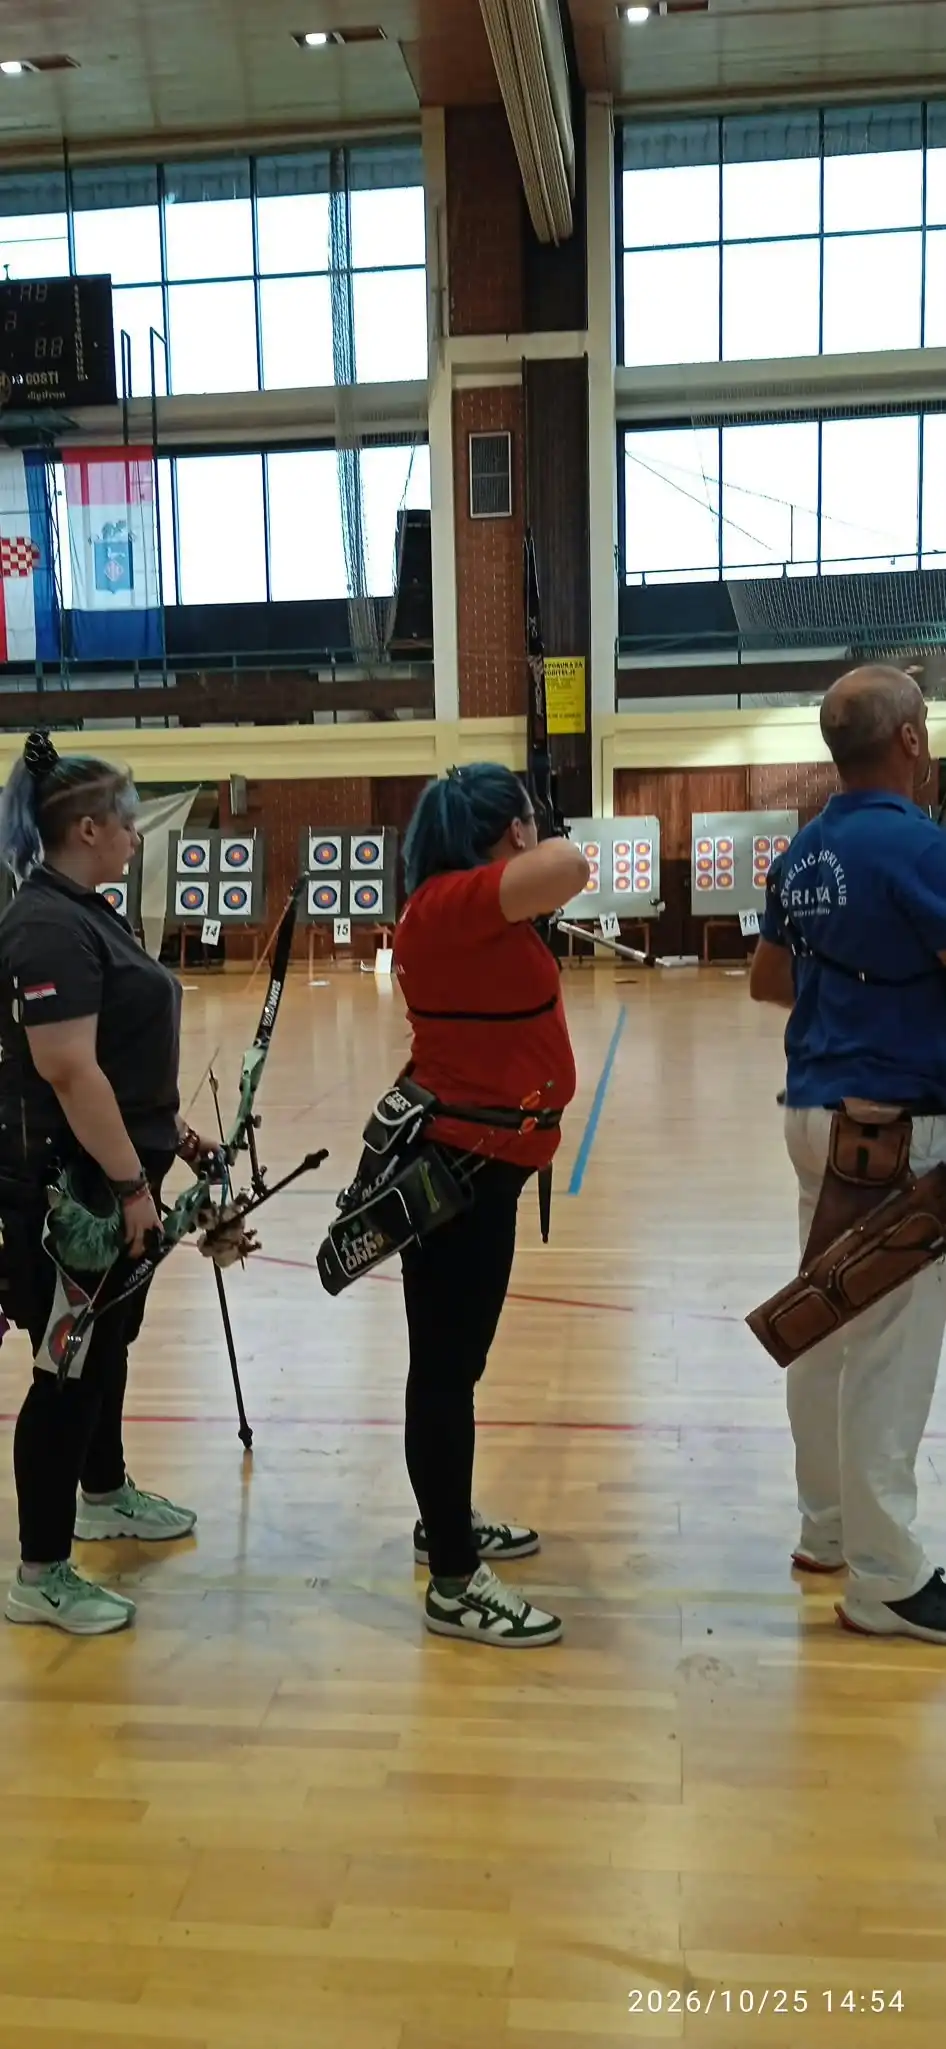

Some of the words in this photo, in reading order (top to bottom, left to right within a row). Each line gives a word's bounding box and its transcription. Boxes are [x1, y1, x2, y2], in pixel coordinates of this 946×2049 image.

[204, 924, 218, 937] 14
[336, 923, 349, 935] 15
[603, 917, 616, 932] 17
[346, 1241, 378, 1270] ONE
